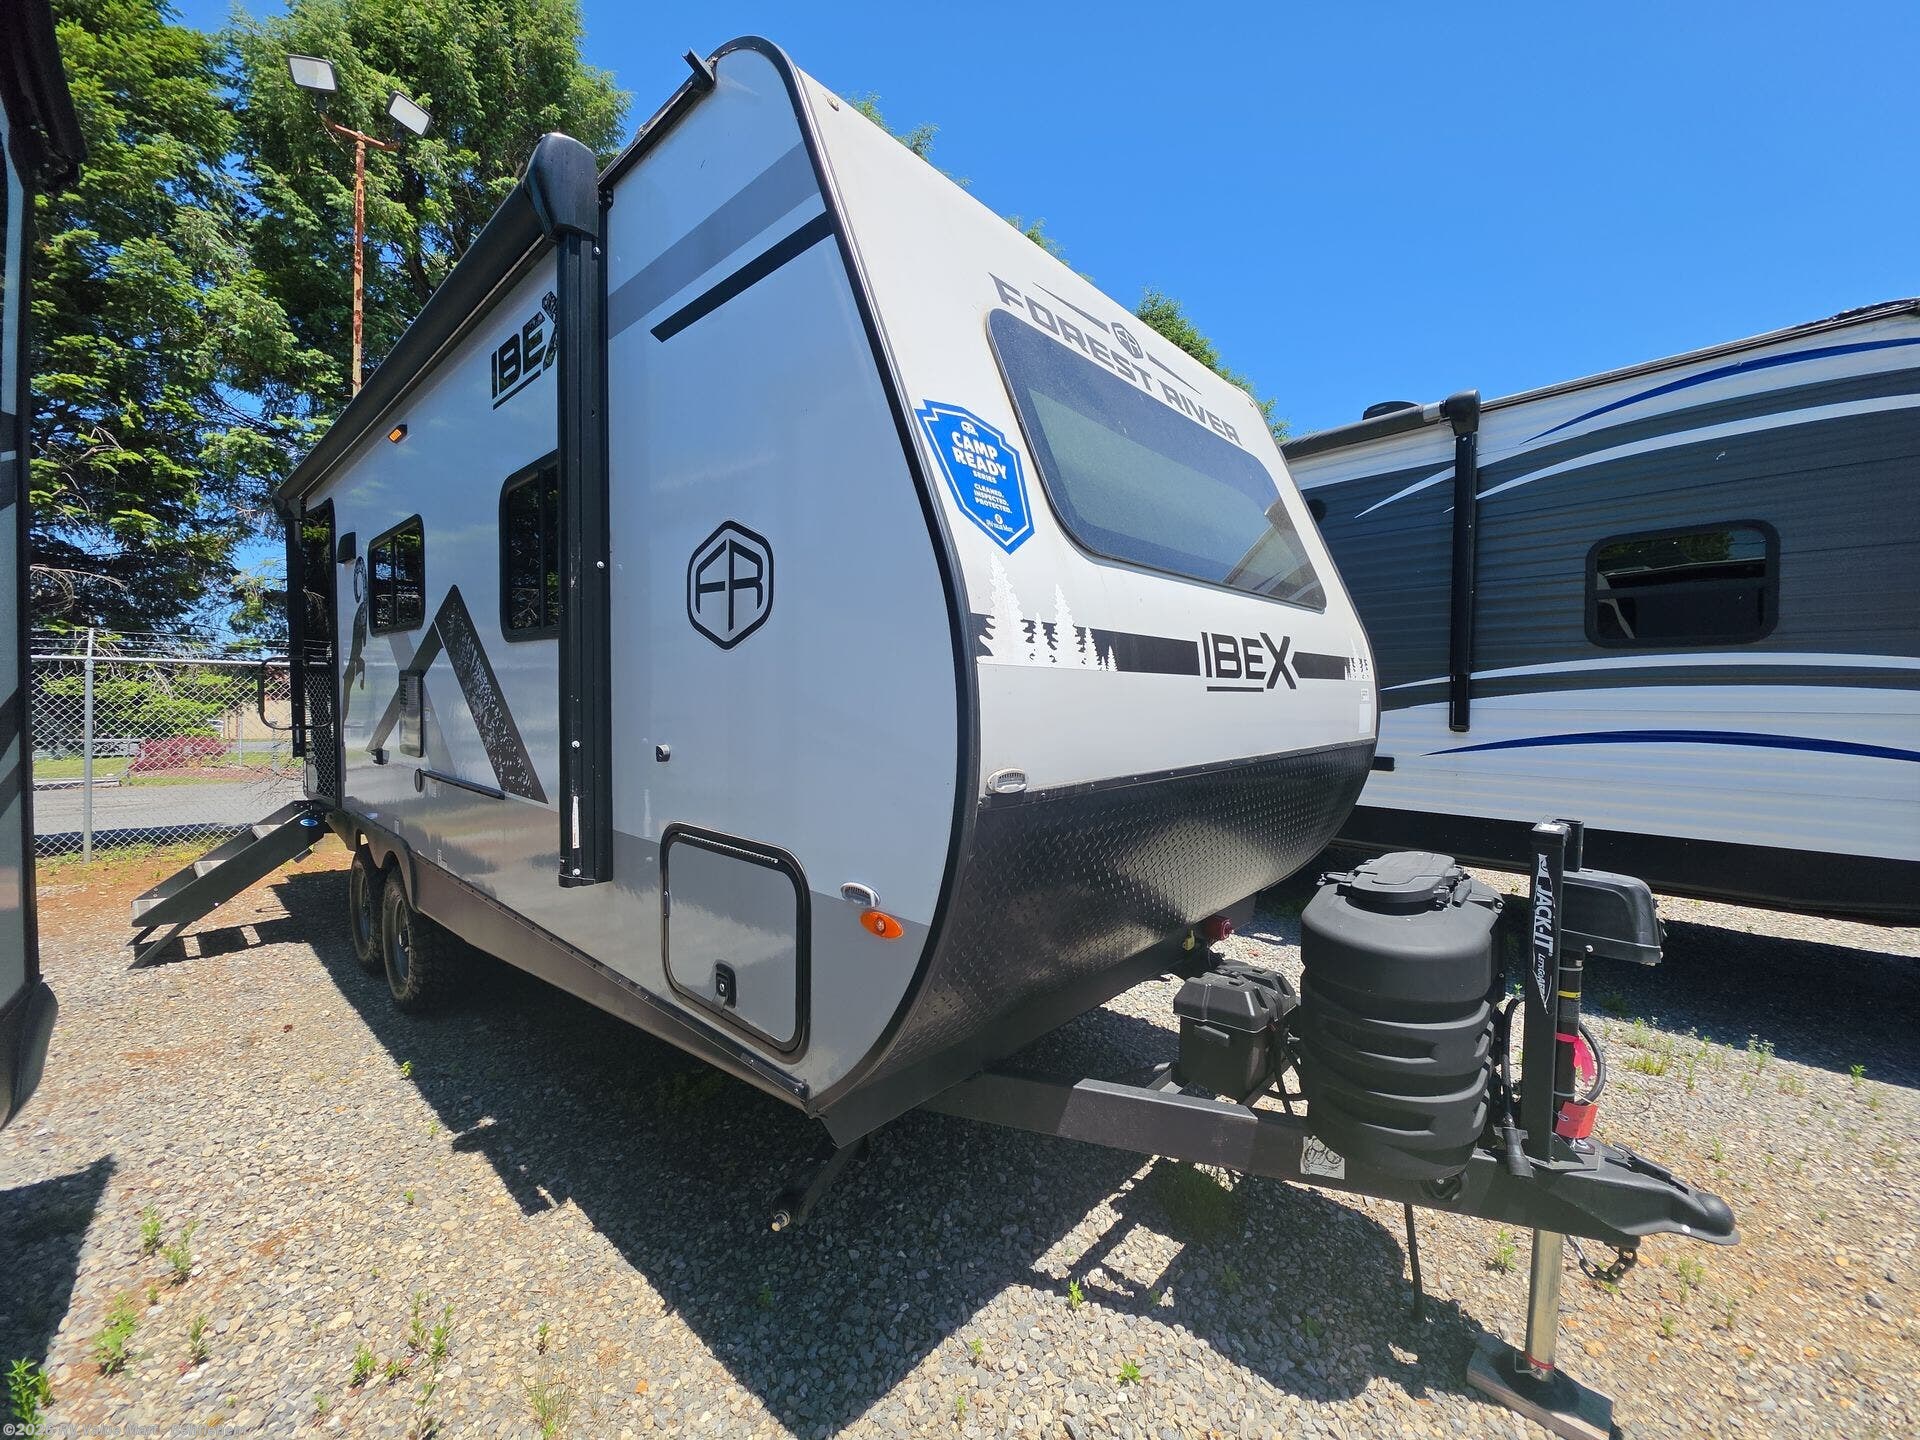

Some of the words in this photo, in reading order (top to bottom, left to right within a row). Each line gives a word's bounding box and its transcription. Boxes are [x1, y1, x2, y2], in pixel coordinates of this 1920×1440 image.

[988, 272, 1153, 392] FOREST
[1157, 379, 1242, 446] RIVER
[952, 431, 998, 460] CAMP
[952, 446, 1007, 480] READY
[972, 470, 997, 484] SERIES
[1201, 631, 1297, 690] IBEX
[1534, 886, 1554, 953] JACK-IT
